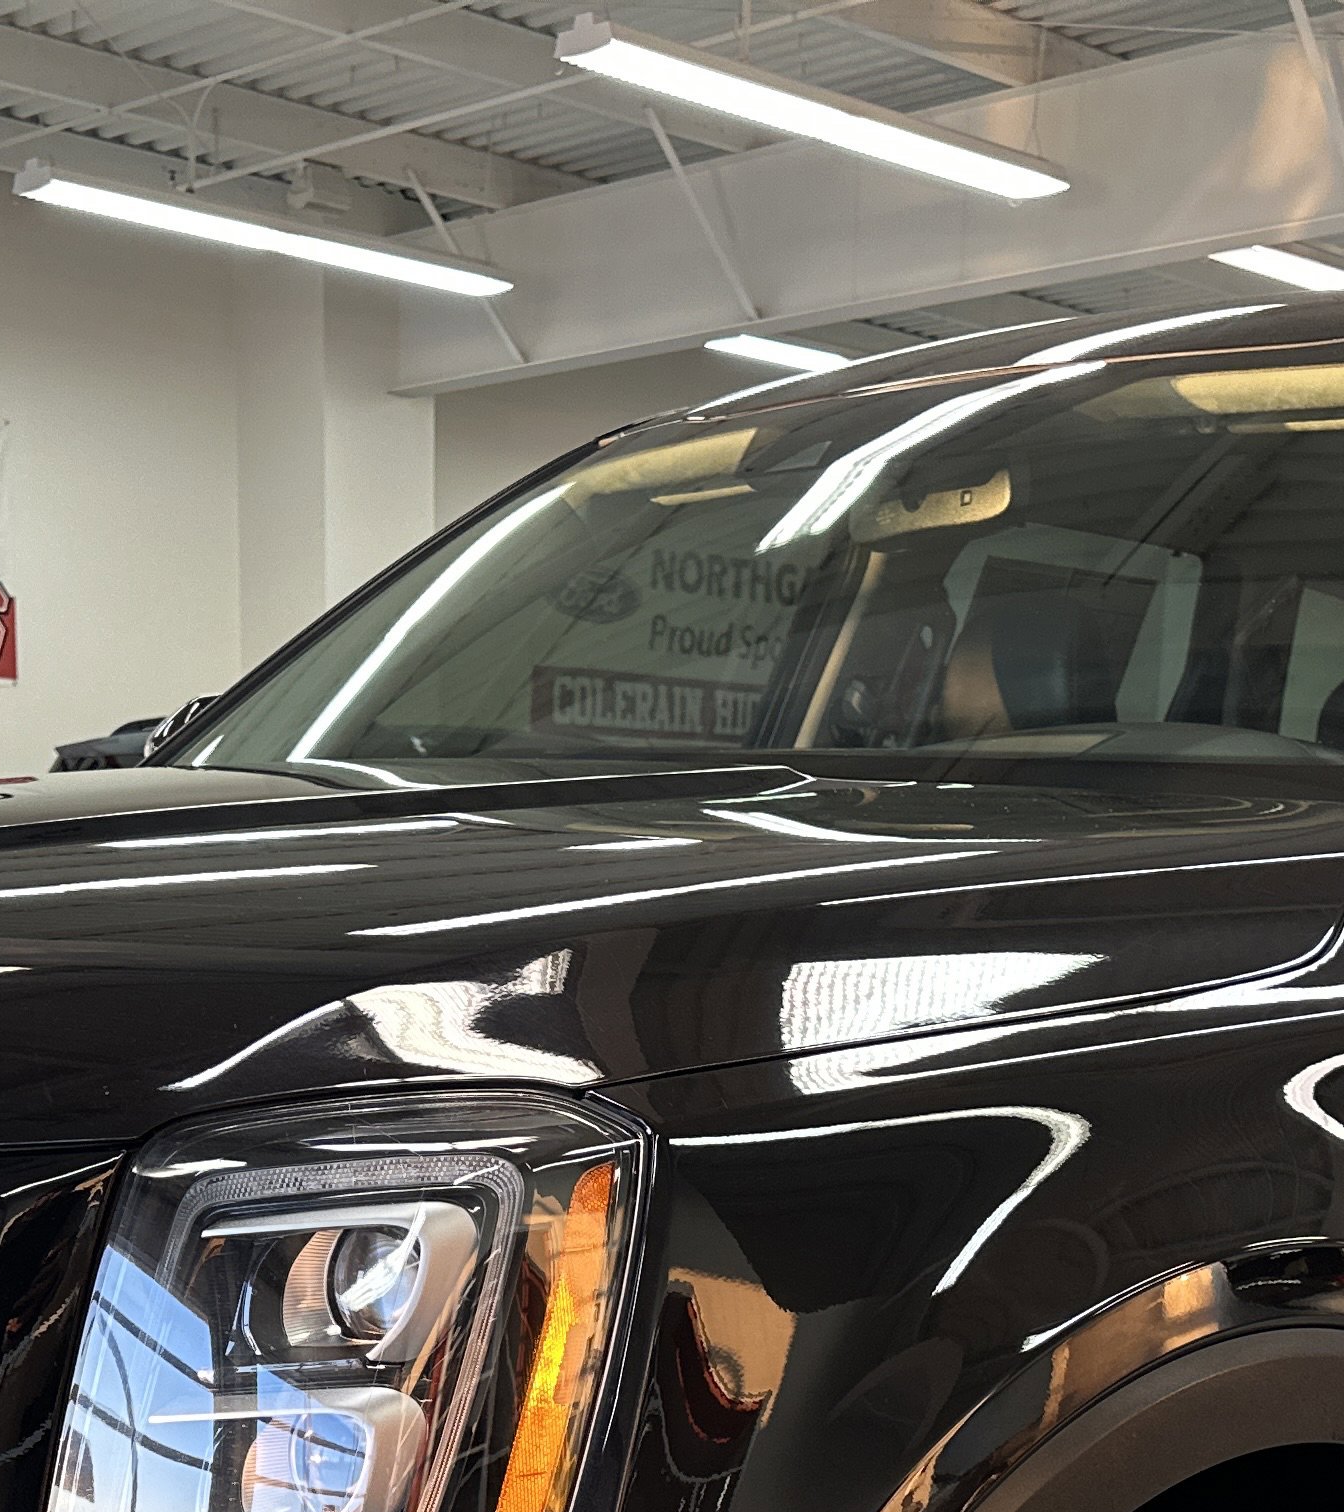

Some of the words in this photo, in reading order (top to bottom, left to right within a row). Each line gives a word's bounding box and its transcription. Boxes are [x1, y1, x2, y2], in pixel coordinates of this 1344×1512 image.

[651, 549, 803, 606] NORTHG
[650, 613, 733, 658] Proud
[554, 675, 707, 733] COLERAIN
